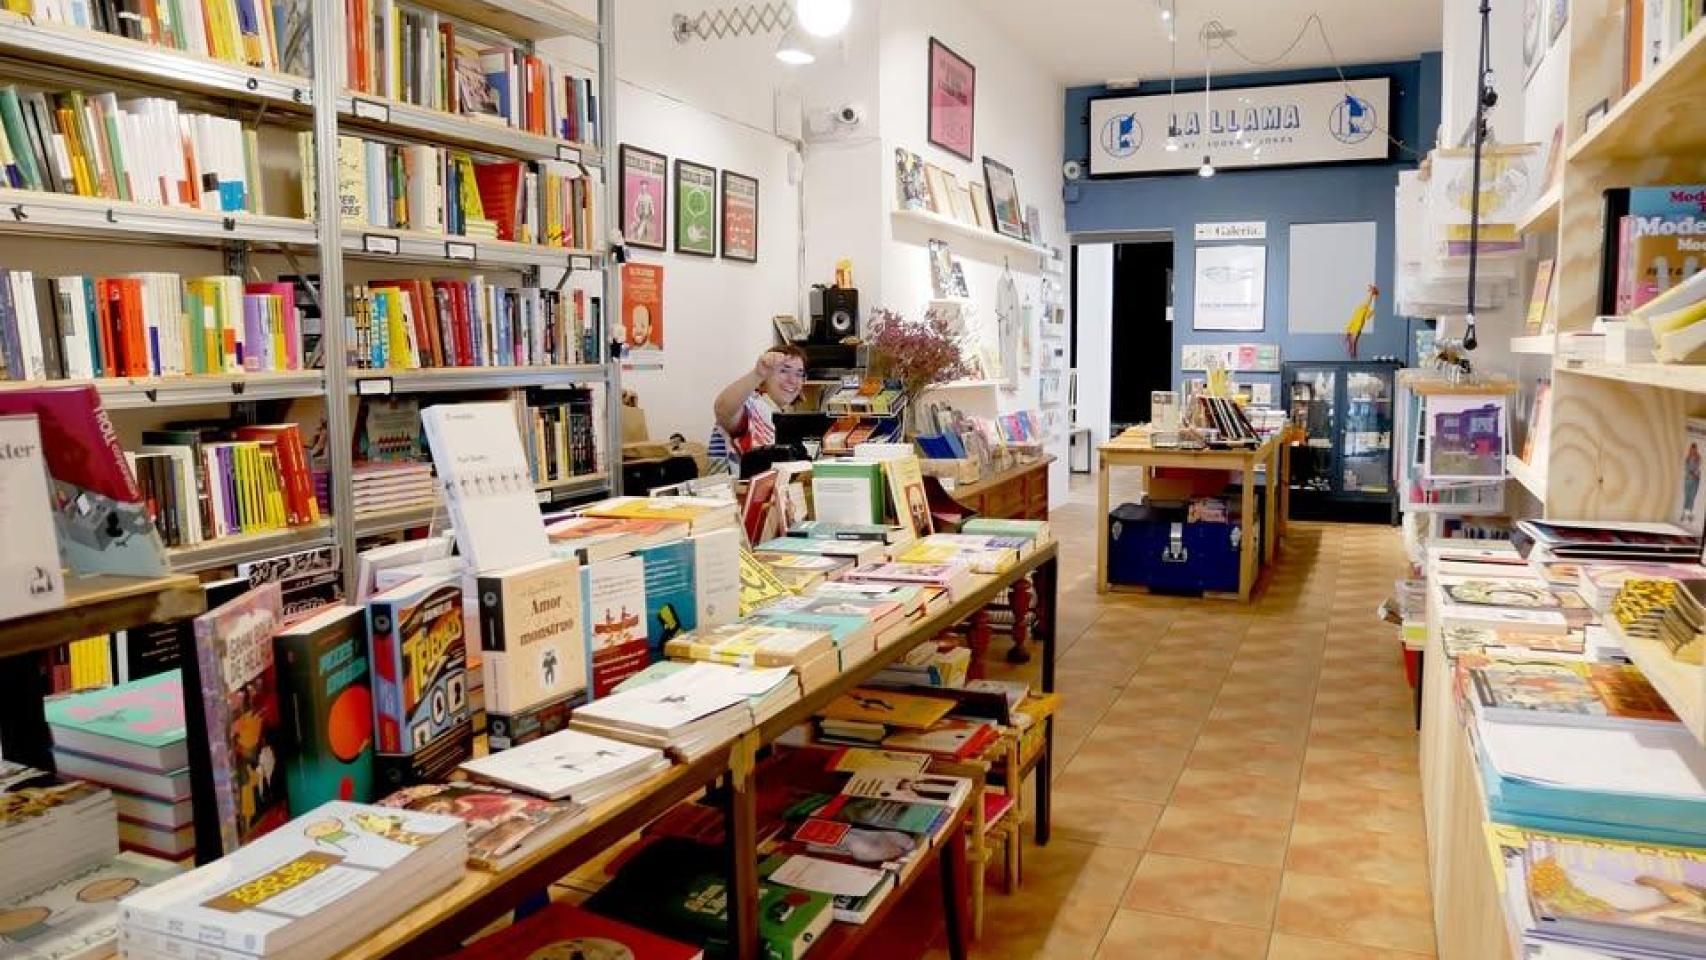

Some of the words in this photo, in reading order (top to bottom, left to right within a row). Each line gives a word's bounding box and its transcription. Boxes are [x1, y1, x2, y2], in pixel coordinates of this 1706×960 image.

[1209, 104, 1300, 133] LLAMA
[10, 204, 28, 221] K
[531, 595, 562, 617] Amor
[519, 617, 575, 648] monstruo
